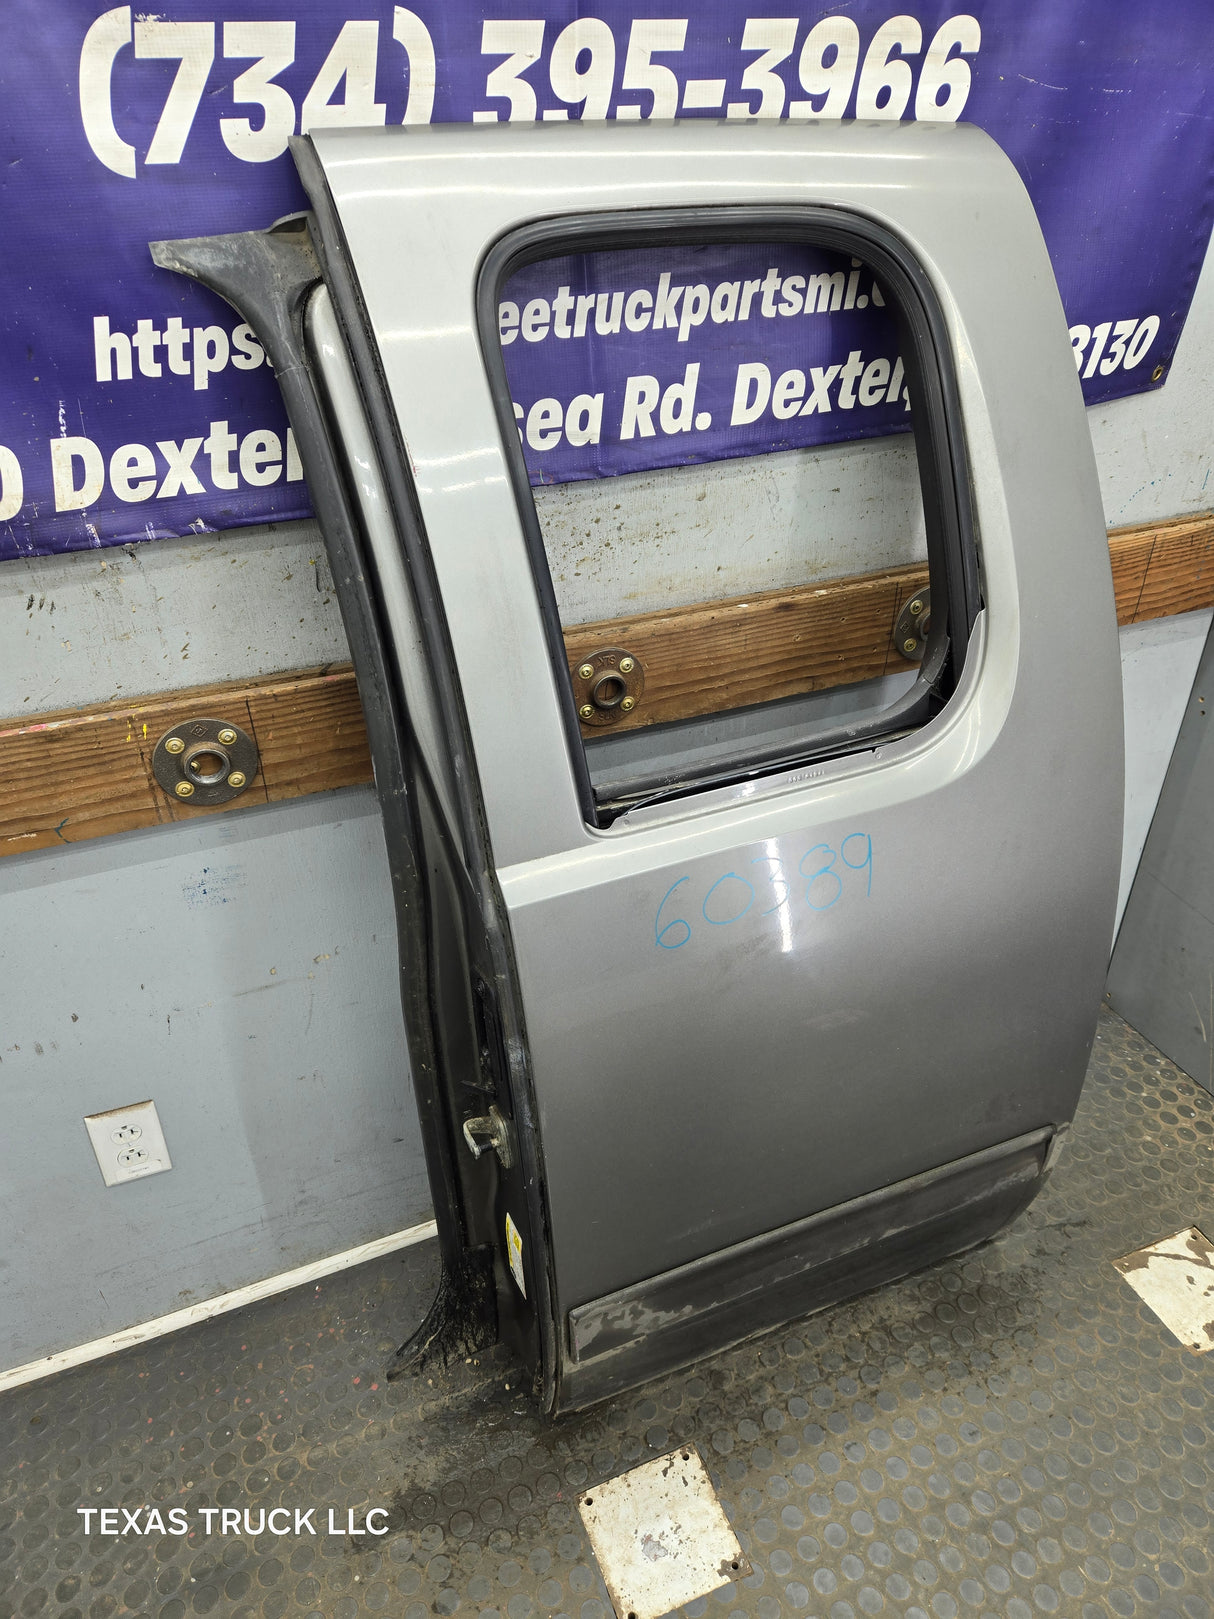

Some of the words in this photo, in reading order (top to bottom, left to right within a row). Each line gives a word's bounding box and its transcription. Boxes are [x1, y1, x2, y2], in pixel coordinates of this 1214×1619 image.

[79, 5, 436, 179] (734)
[472, 15, 982, 124] 395-3966
[93, 316, 273, 390] https
[620, 362, 713, 441] Rd.
